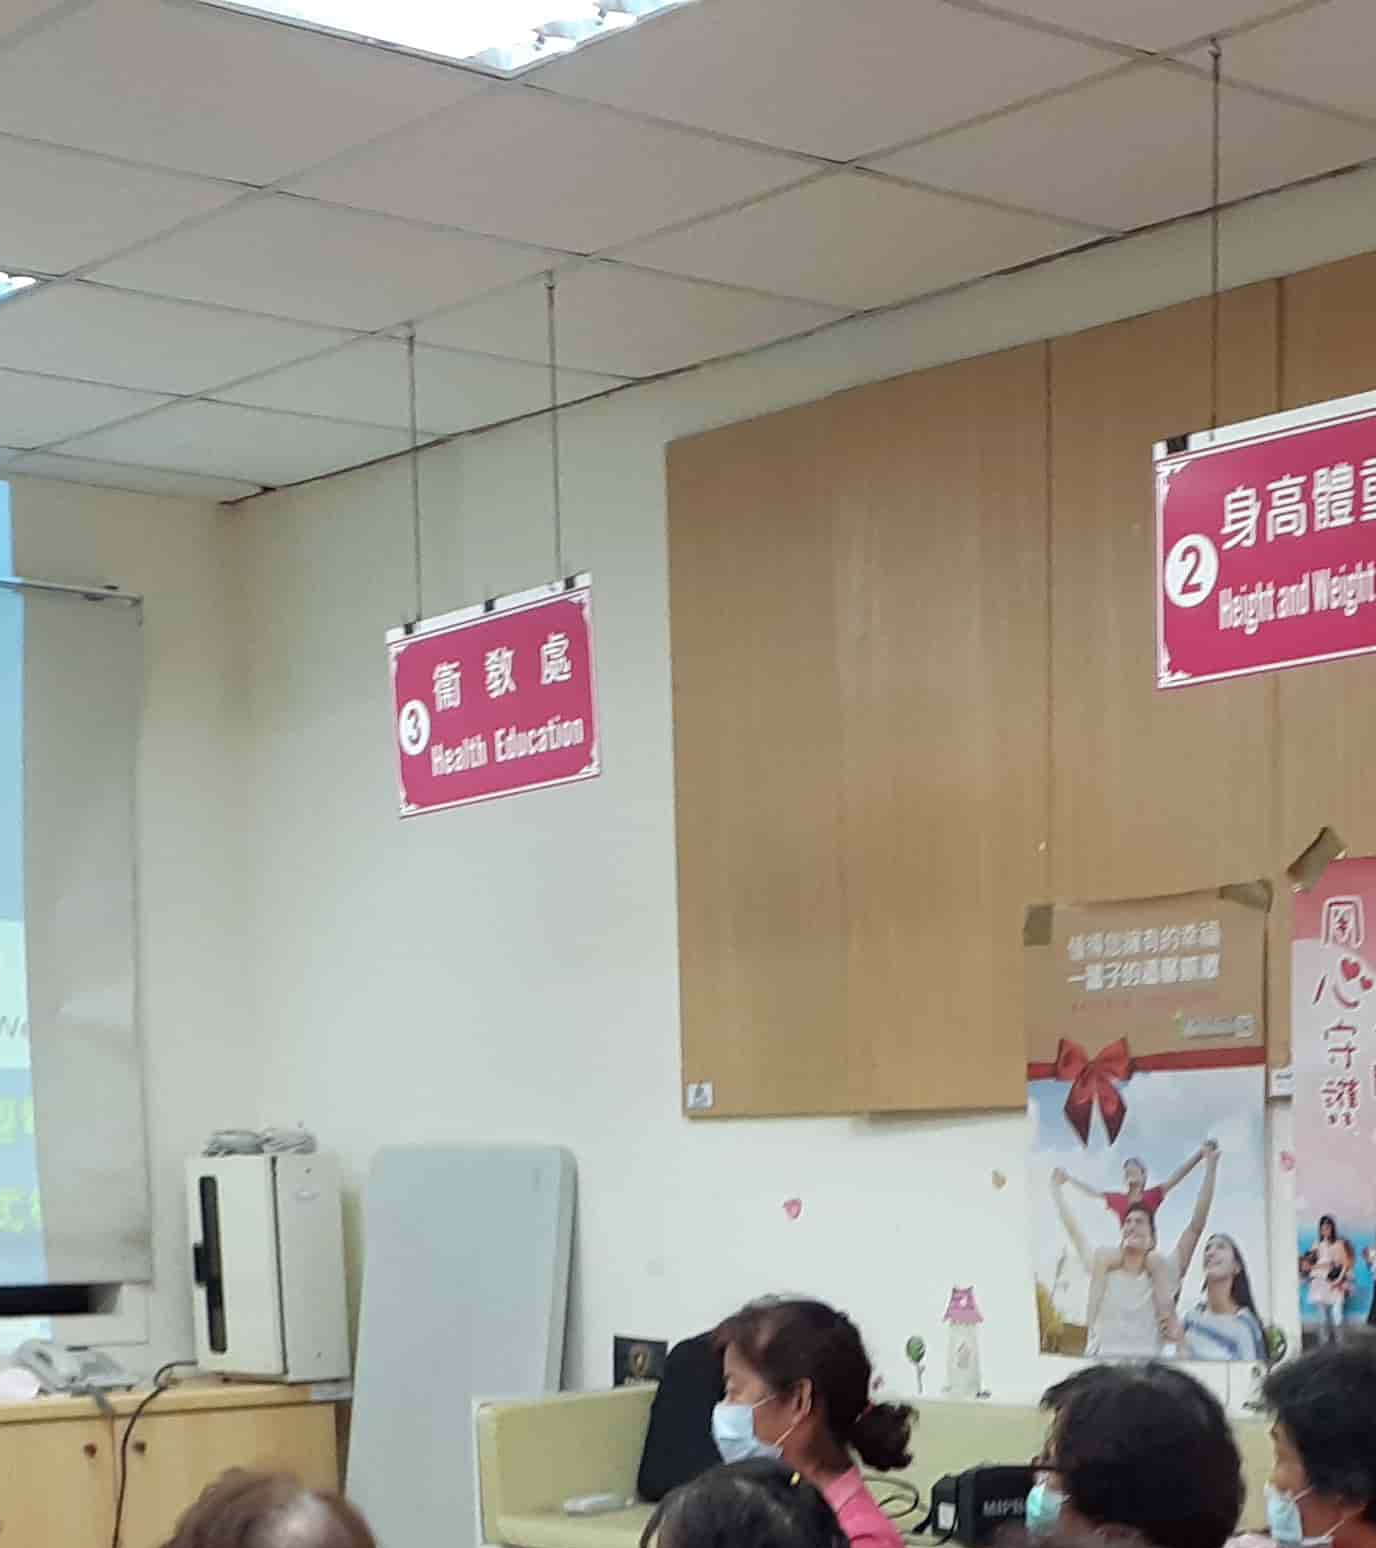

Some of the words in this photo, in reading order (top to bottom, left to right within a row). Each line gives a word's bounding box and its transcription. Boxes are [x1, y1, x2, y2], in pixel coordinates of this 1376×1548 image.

[1218, 578, 1275, 635] Height
[1277, 573, 1310, 619] and
[1312, 558, 1376, 616] Weight
[430, 734, 489, 777] Health
[493, 714, 585, 763] Education
